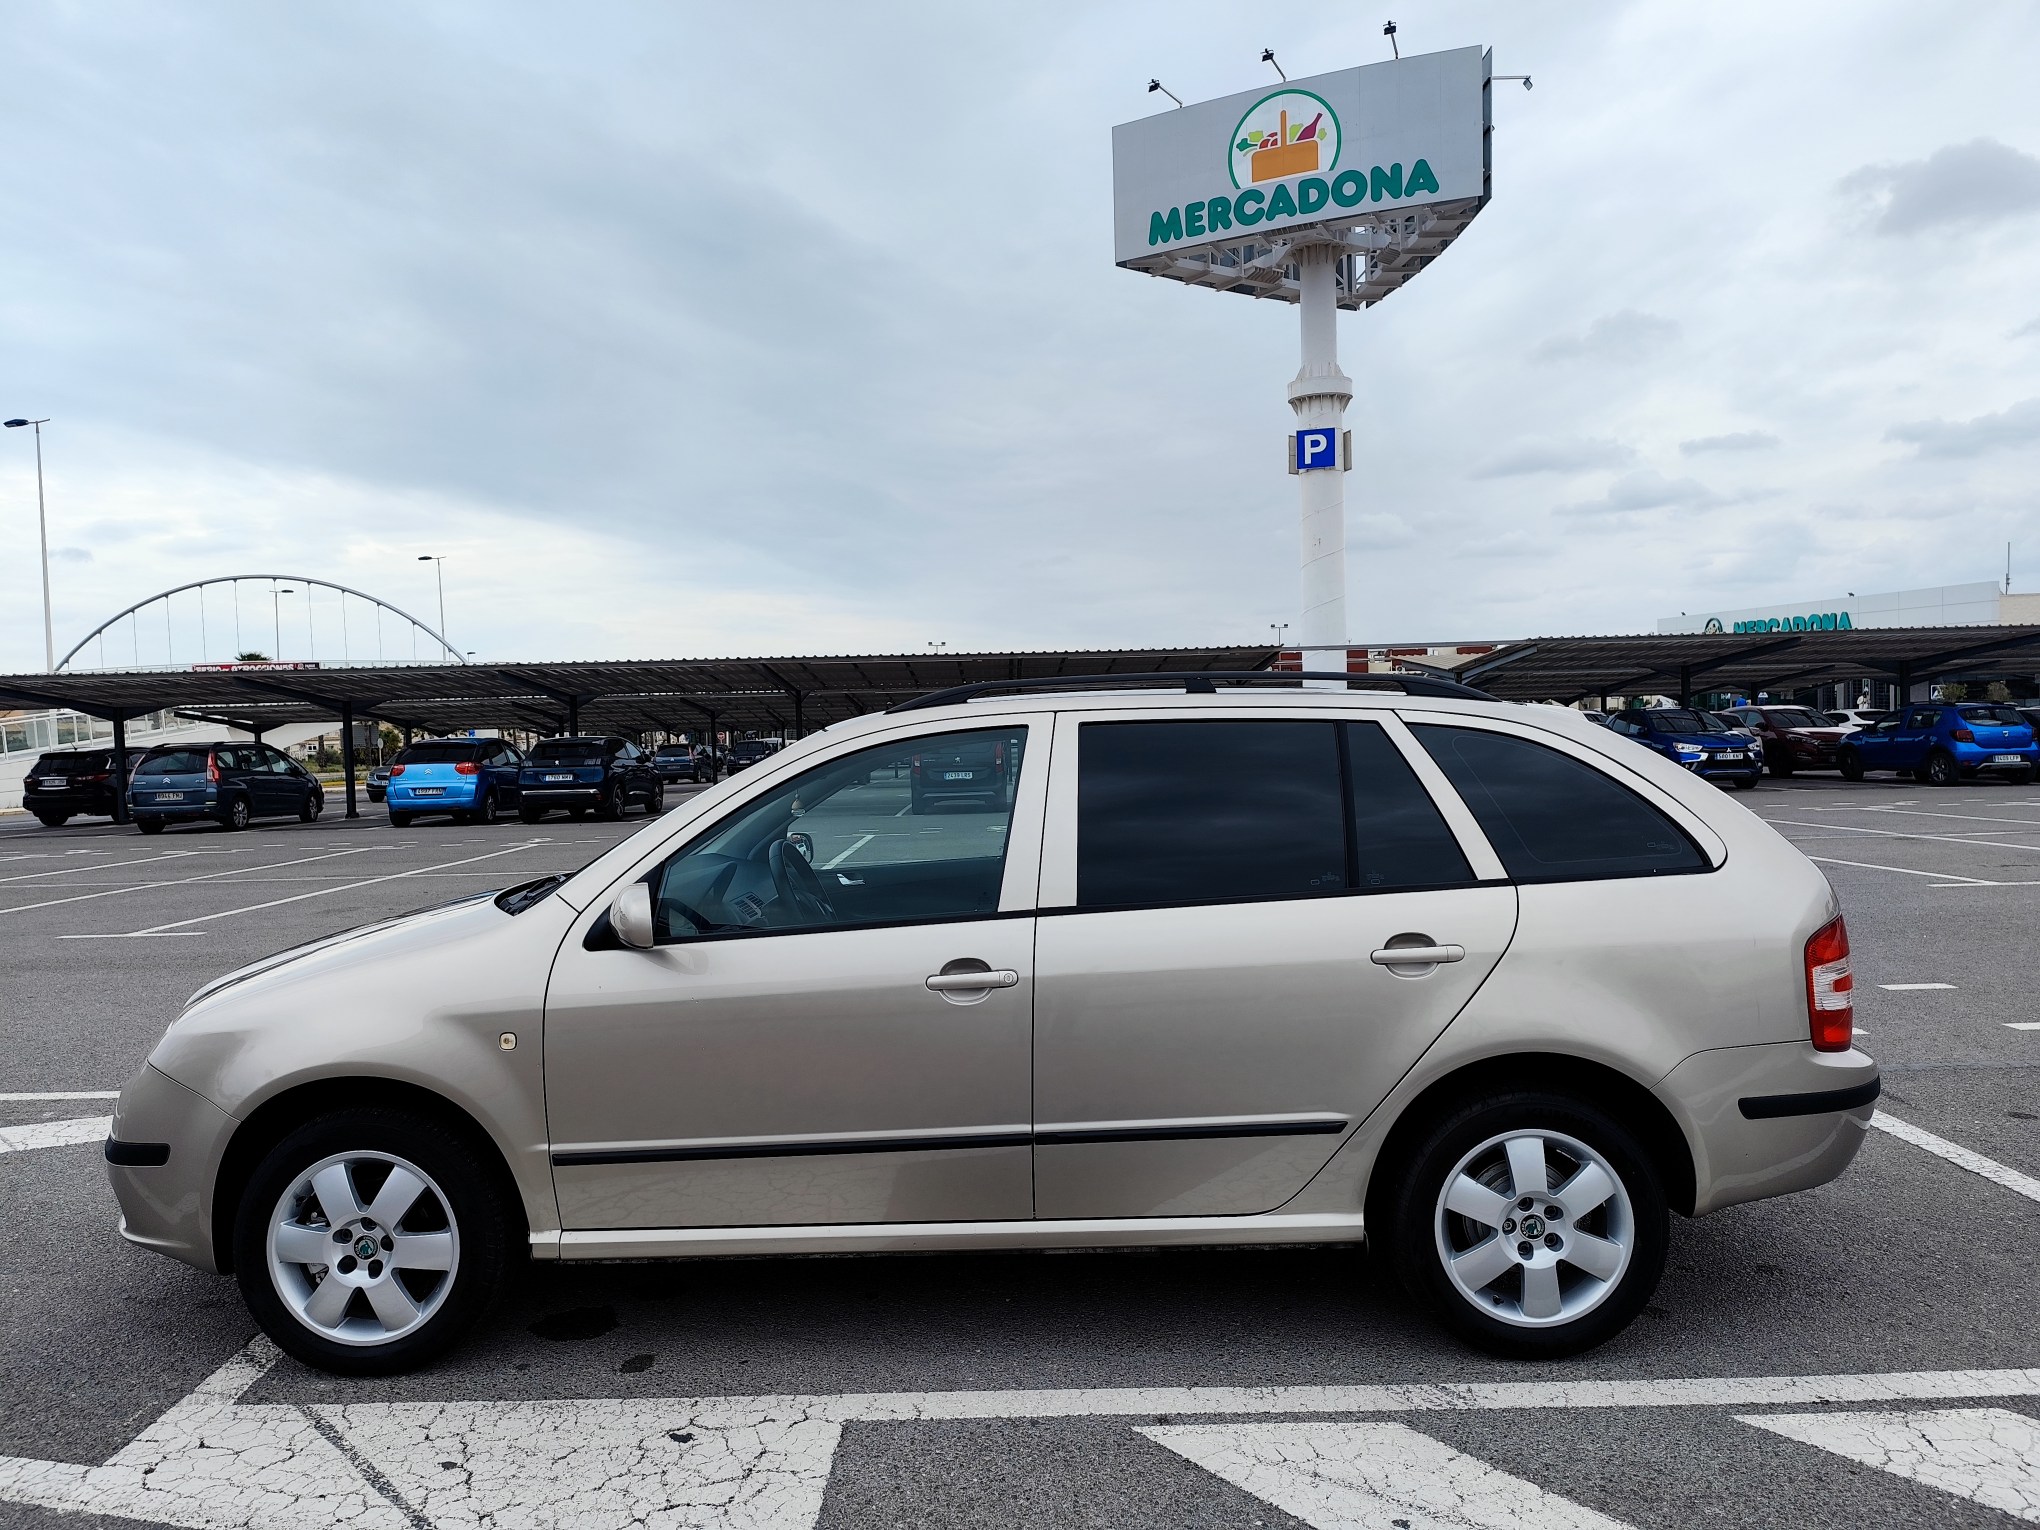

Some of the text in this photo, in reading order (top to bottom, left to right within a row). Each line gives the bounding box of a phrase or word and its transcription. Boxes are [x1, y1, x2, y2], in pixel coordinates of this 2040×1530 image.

[1149, 159, 1439, 246] MERCADONA
[1304, 434, 1327, 465] P
[1733, 611, 1852, 634] MERCADONA
